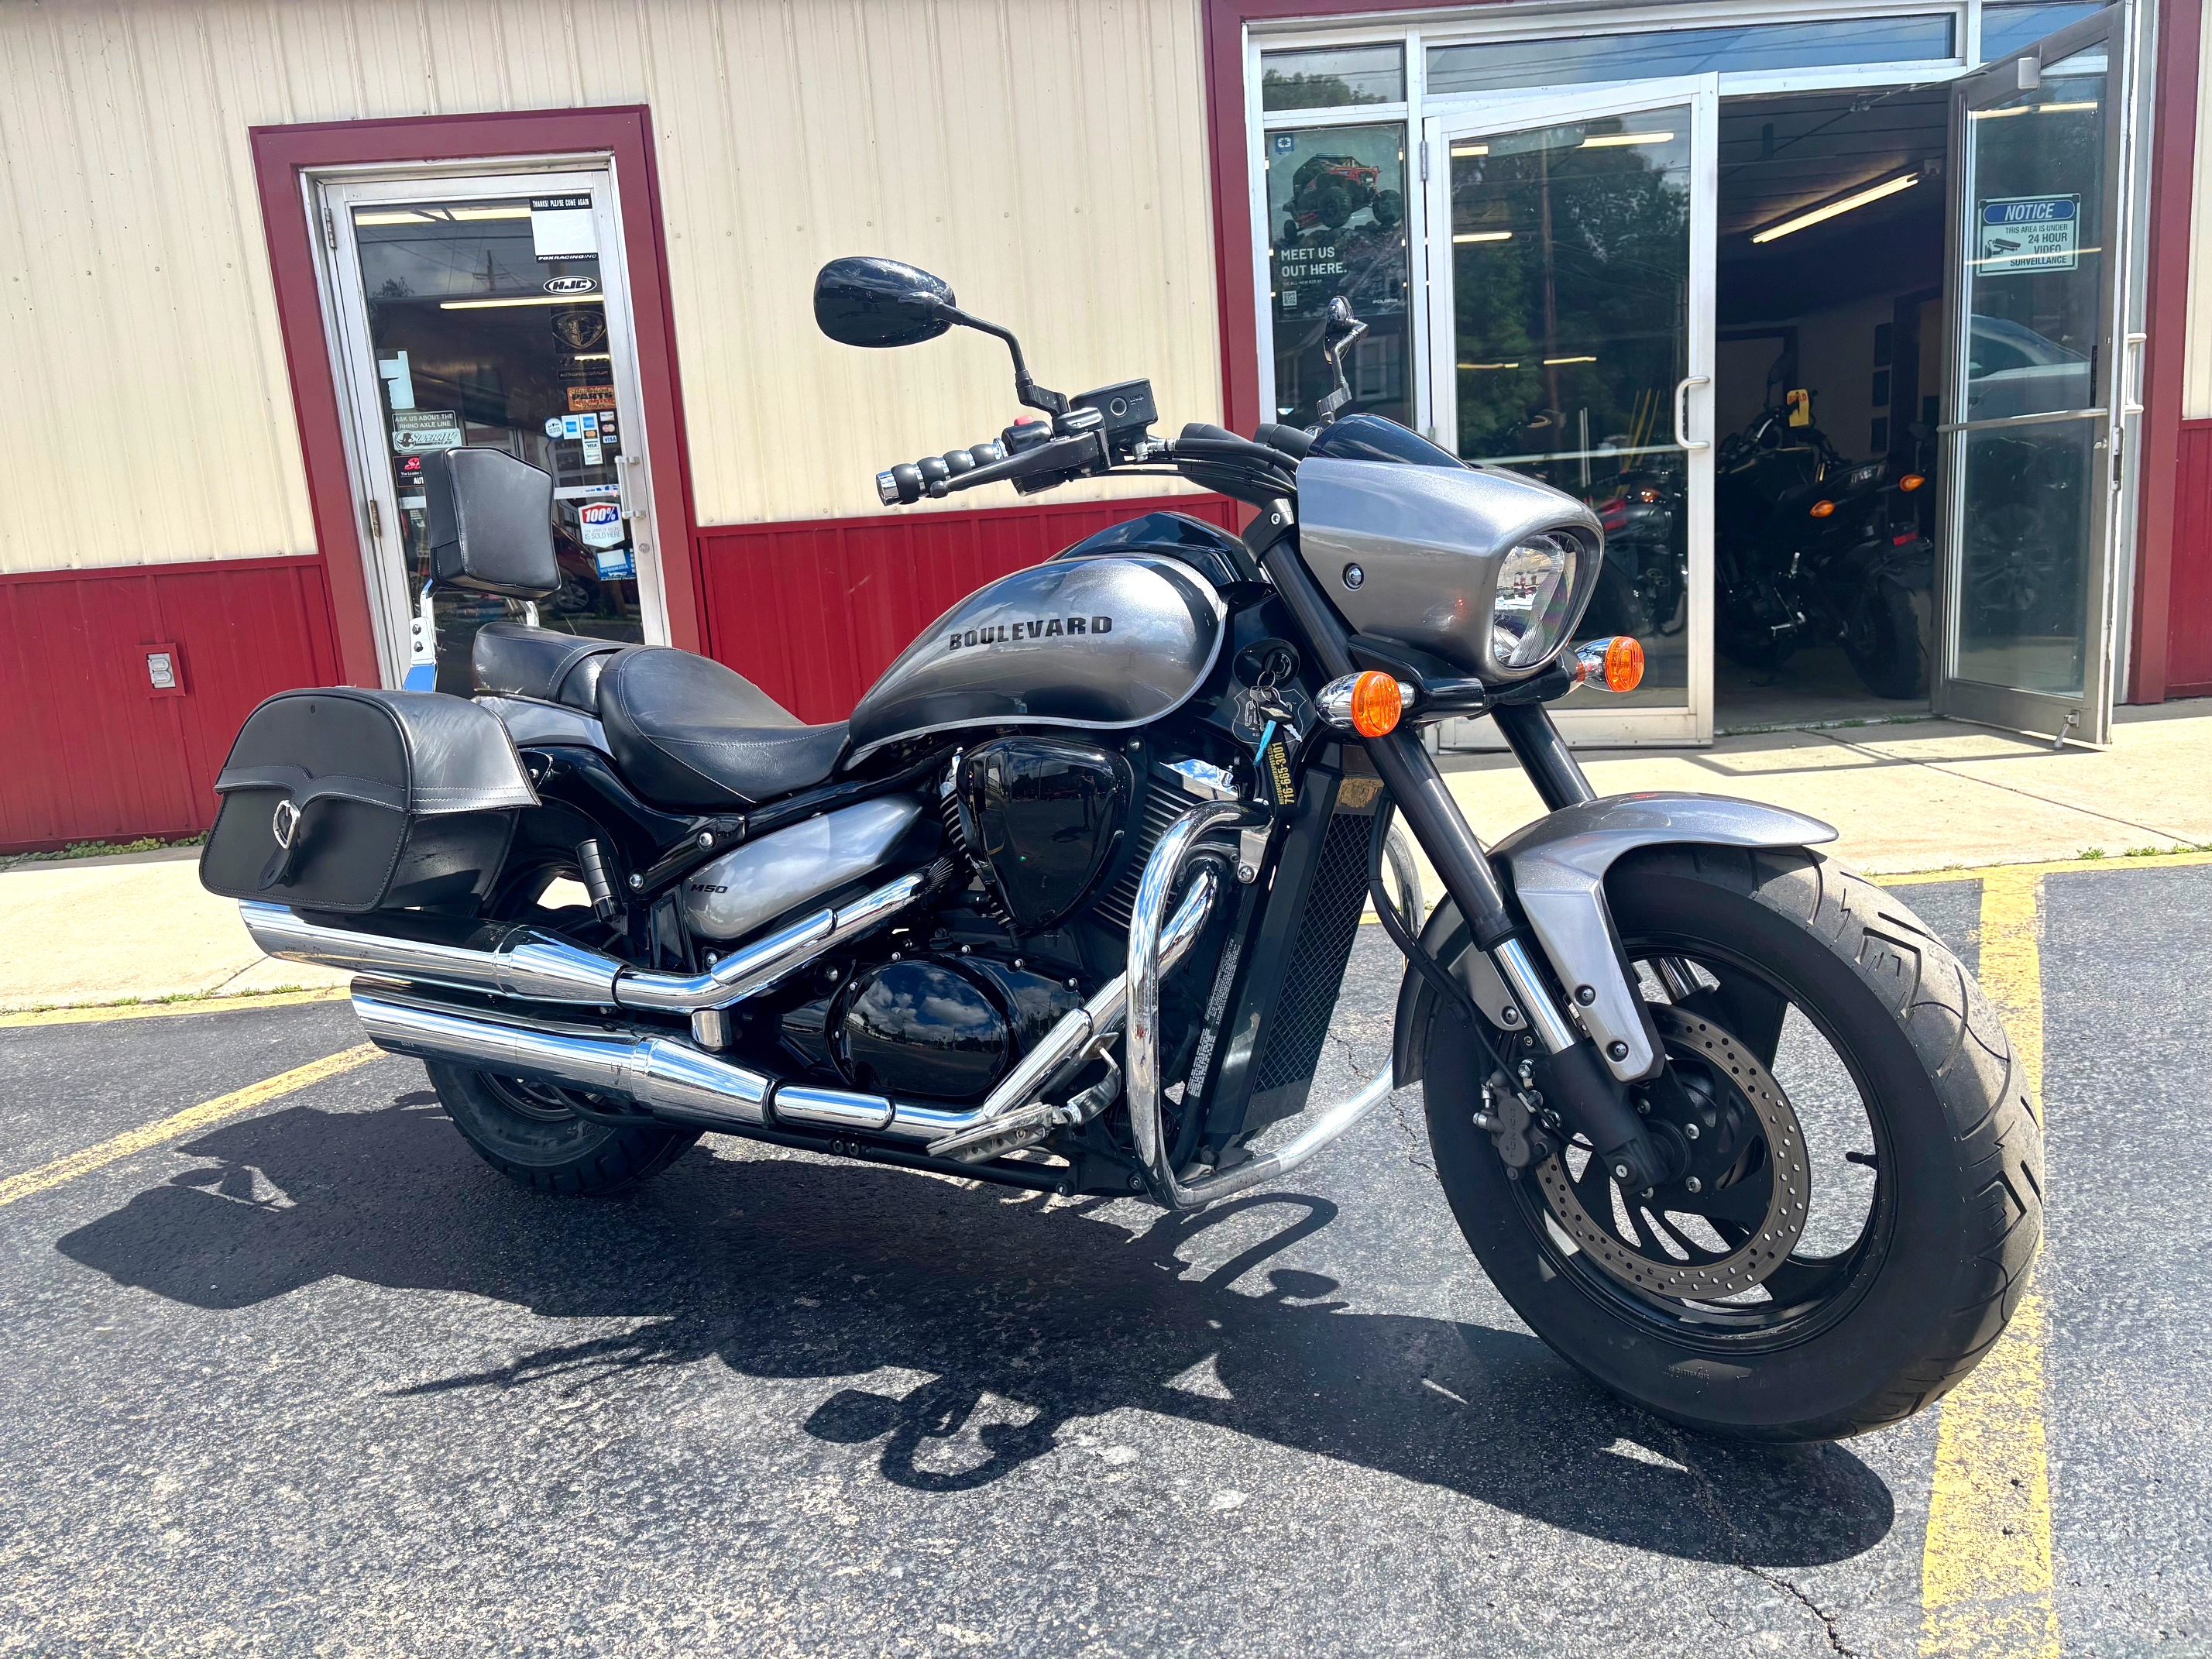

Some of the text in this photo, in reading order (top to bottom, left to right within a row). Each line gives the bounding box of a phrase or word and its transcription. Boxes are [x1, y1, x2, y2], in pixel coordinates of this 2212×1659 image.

[565, 198, 576, 207] COME
[2004, 203, 2055, 222] NOTICE
[2028, 232, 2067, 244] 24 HOUR
[1281, 246, 1335, 261] MEET US
[2034, 245, 2061, 255] VIDEO
[2010, 256, 2067, 266] SURVEILLANCE
[1282, 262, 1348, 277] OUT HERE.
[552, 280, 588, 290] HJC
[585, 507, 616, 523] 100%
[950, 617, 1112, 651] BOULEVARD
[1272, 742, 1295, 805] 716-665-3001
[690, 884, 728, 894] M50
